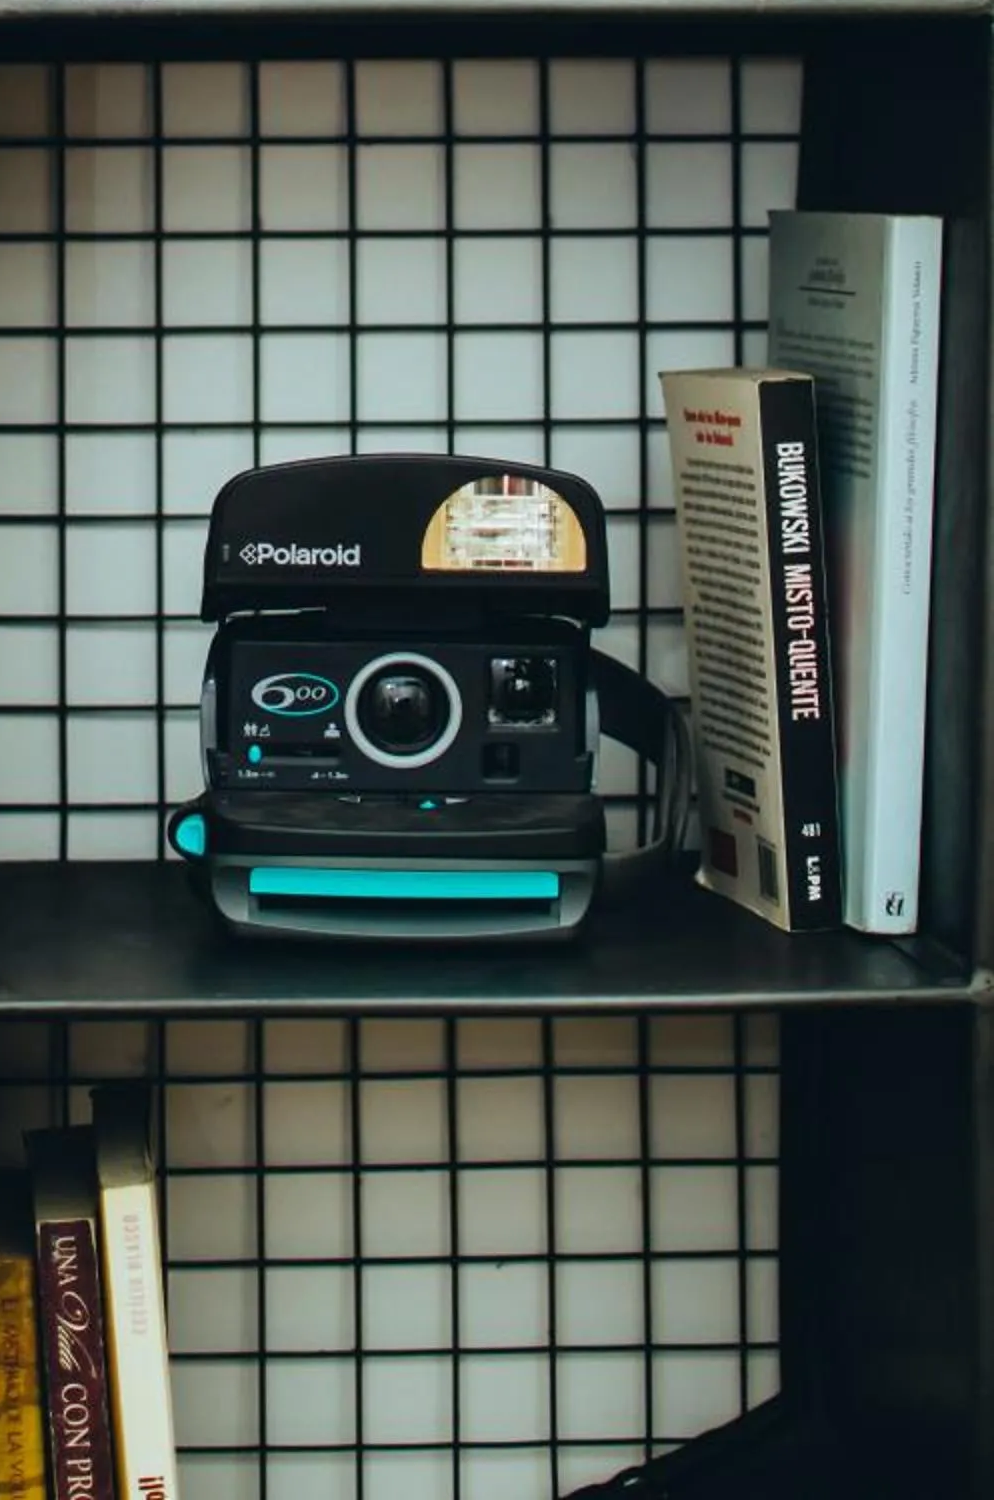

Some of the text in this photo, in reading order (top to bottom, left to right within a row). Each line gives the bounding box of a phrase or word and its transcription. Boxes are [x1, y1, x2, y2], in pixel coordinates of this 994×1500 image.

[257, 543, 361, 566] Polaroid
[776, 441, 820, 722] BUKOWSKI MISTO-QUENTE
[252, 673, 327, 710] 600
[55, 1235, 78, 1287] UNA
[61, 1383, 91, 1447] CON
